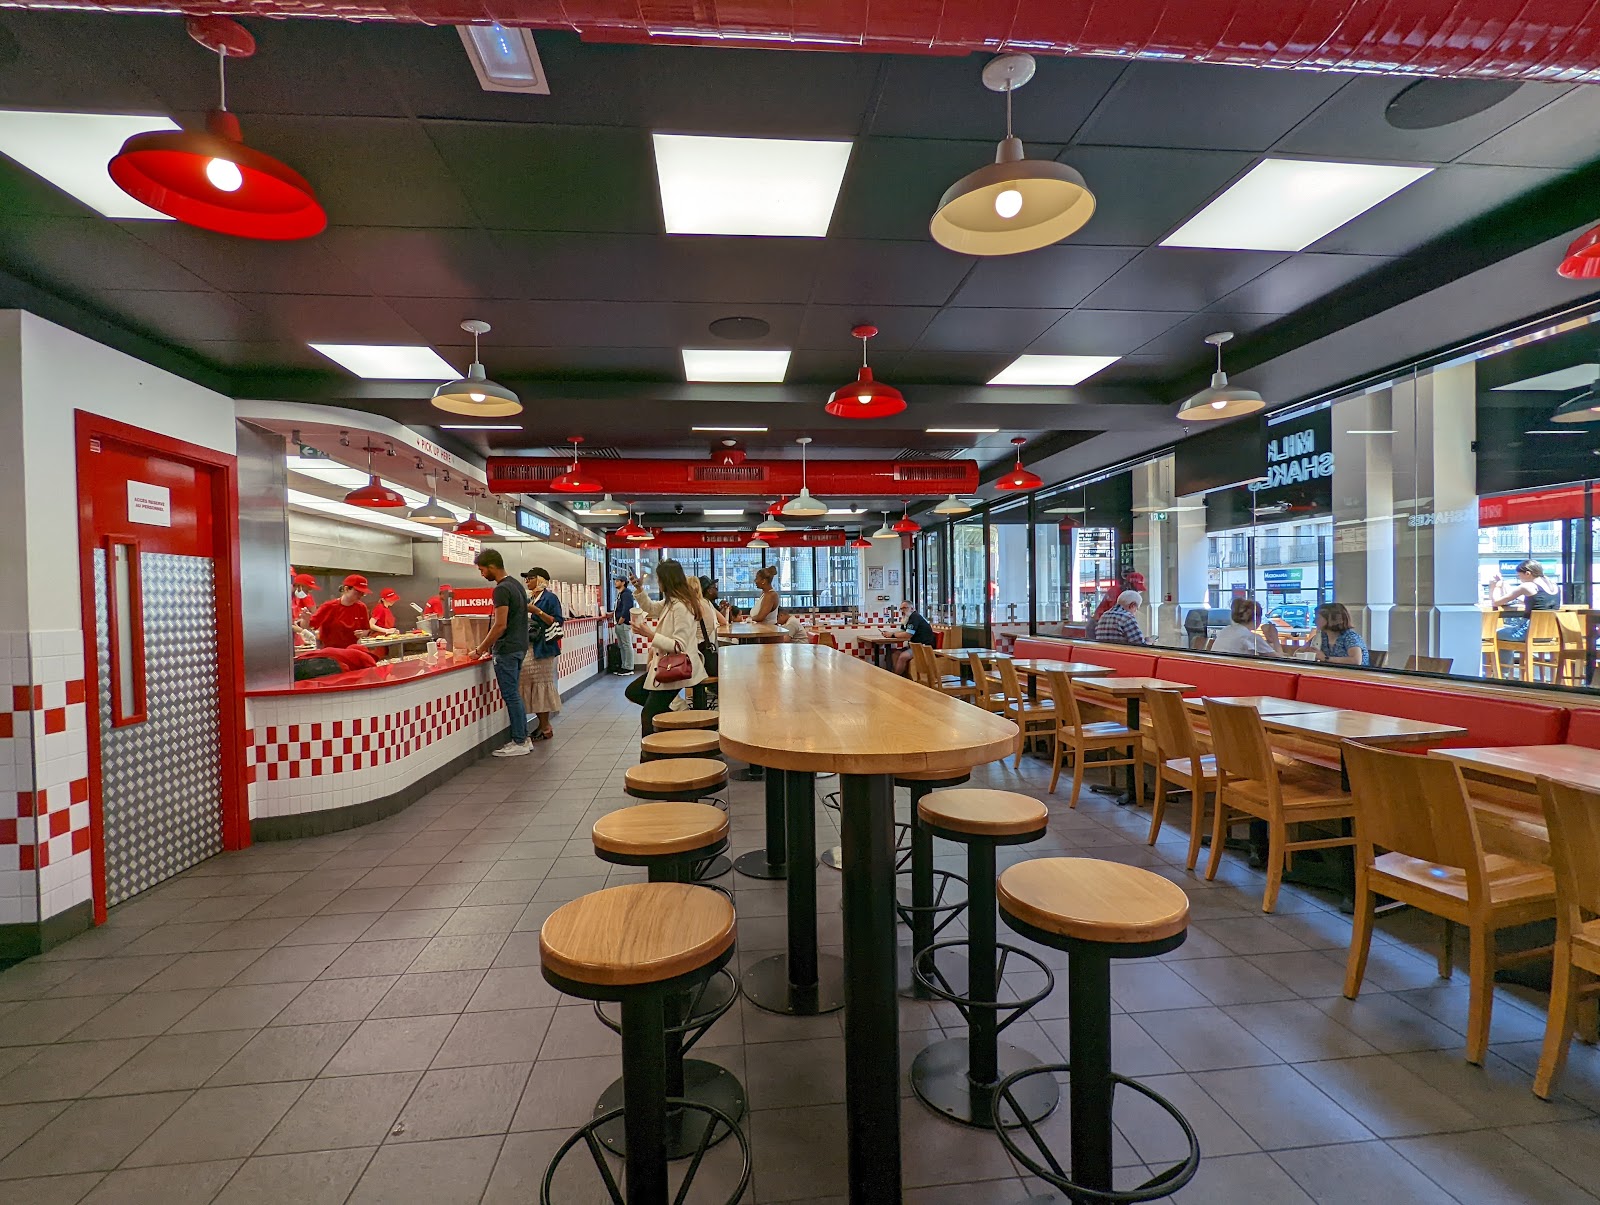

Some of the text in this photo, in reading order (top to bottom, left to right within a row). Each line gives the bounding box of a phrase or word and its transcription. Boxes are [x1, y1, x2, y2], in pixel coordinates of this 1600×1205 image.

[421, 439, 452, 463] PICK UP HERE
[454, 598, 494, 607] MILKSHA
